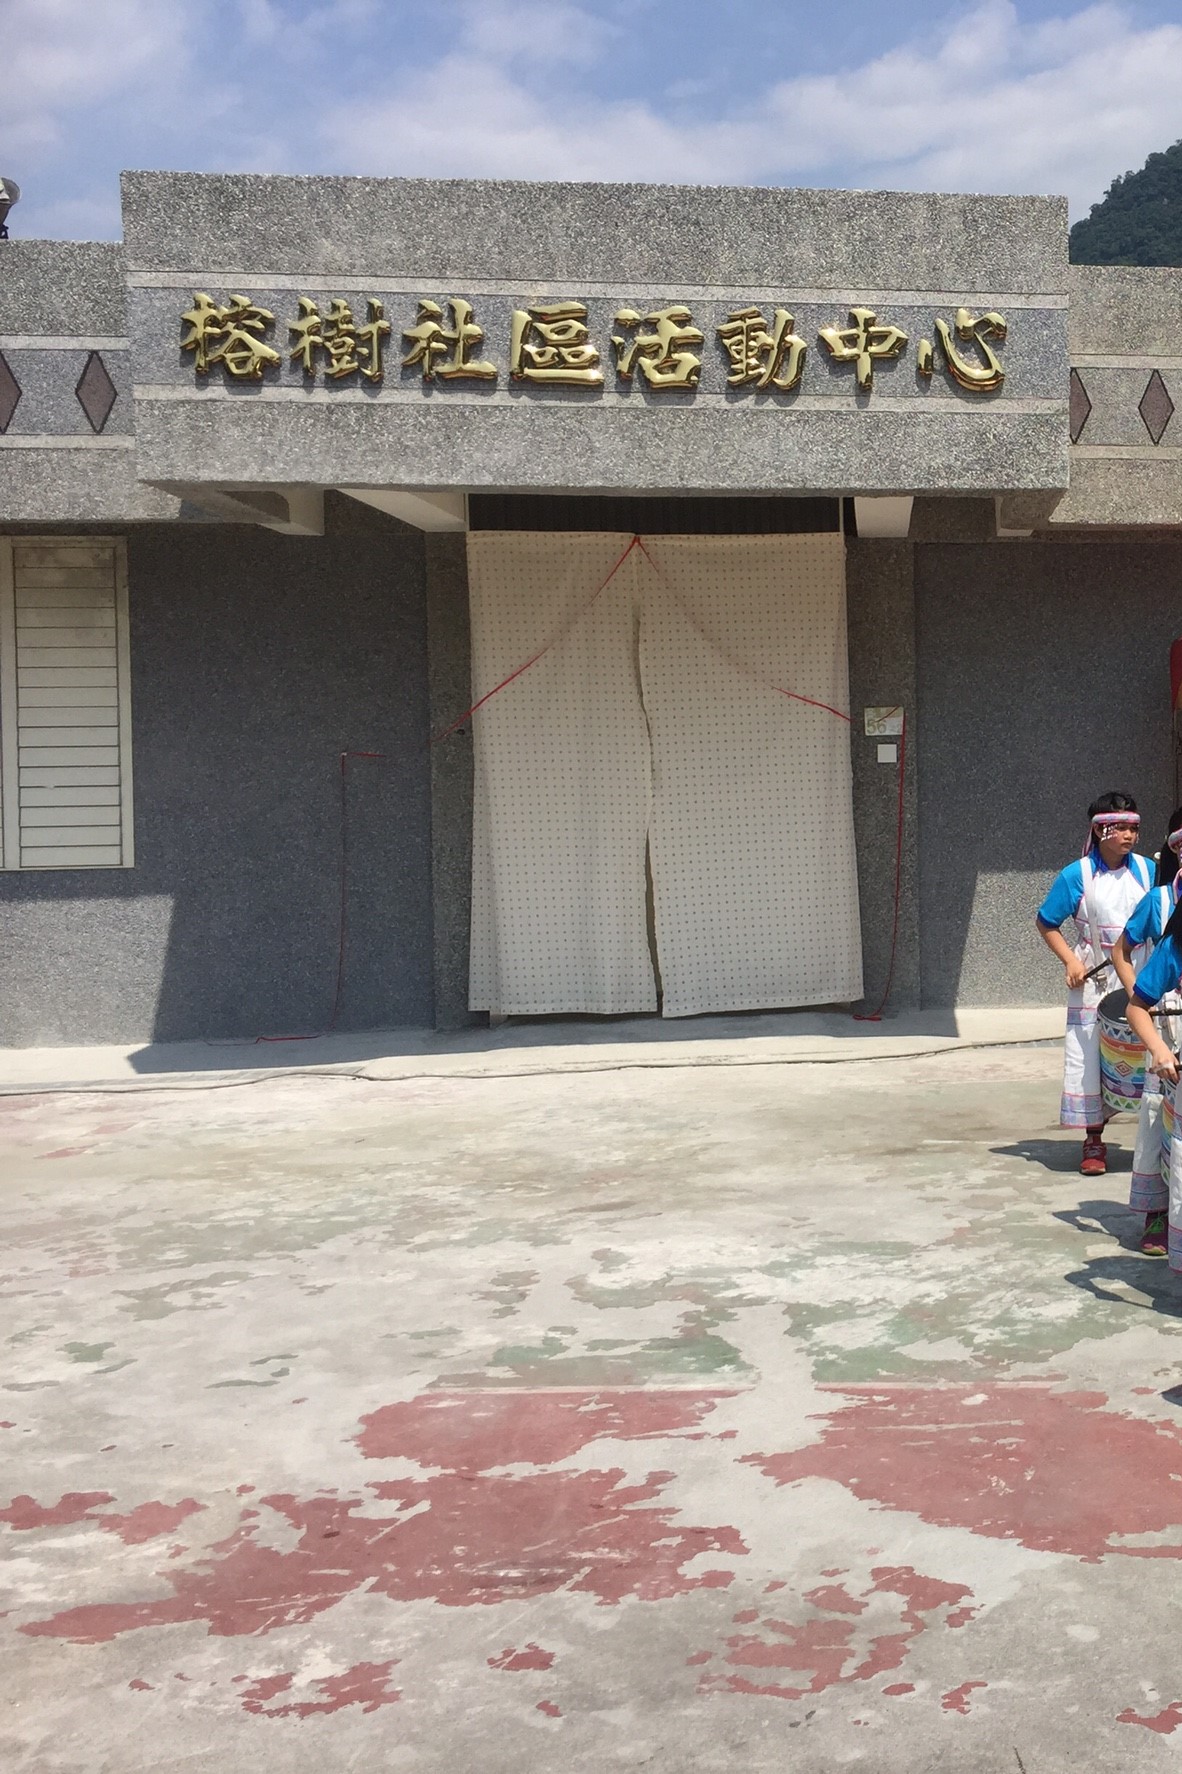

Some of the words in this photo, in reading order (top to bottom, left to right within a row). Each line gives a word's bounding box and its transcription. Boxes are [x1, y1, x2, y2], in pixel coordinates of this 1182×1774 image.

[180, 292, 1008, 392] 榕樹社區活動中心
